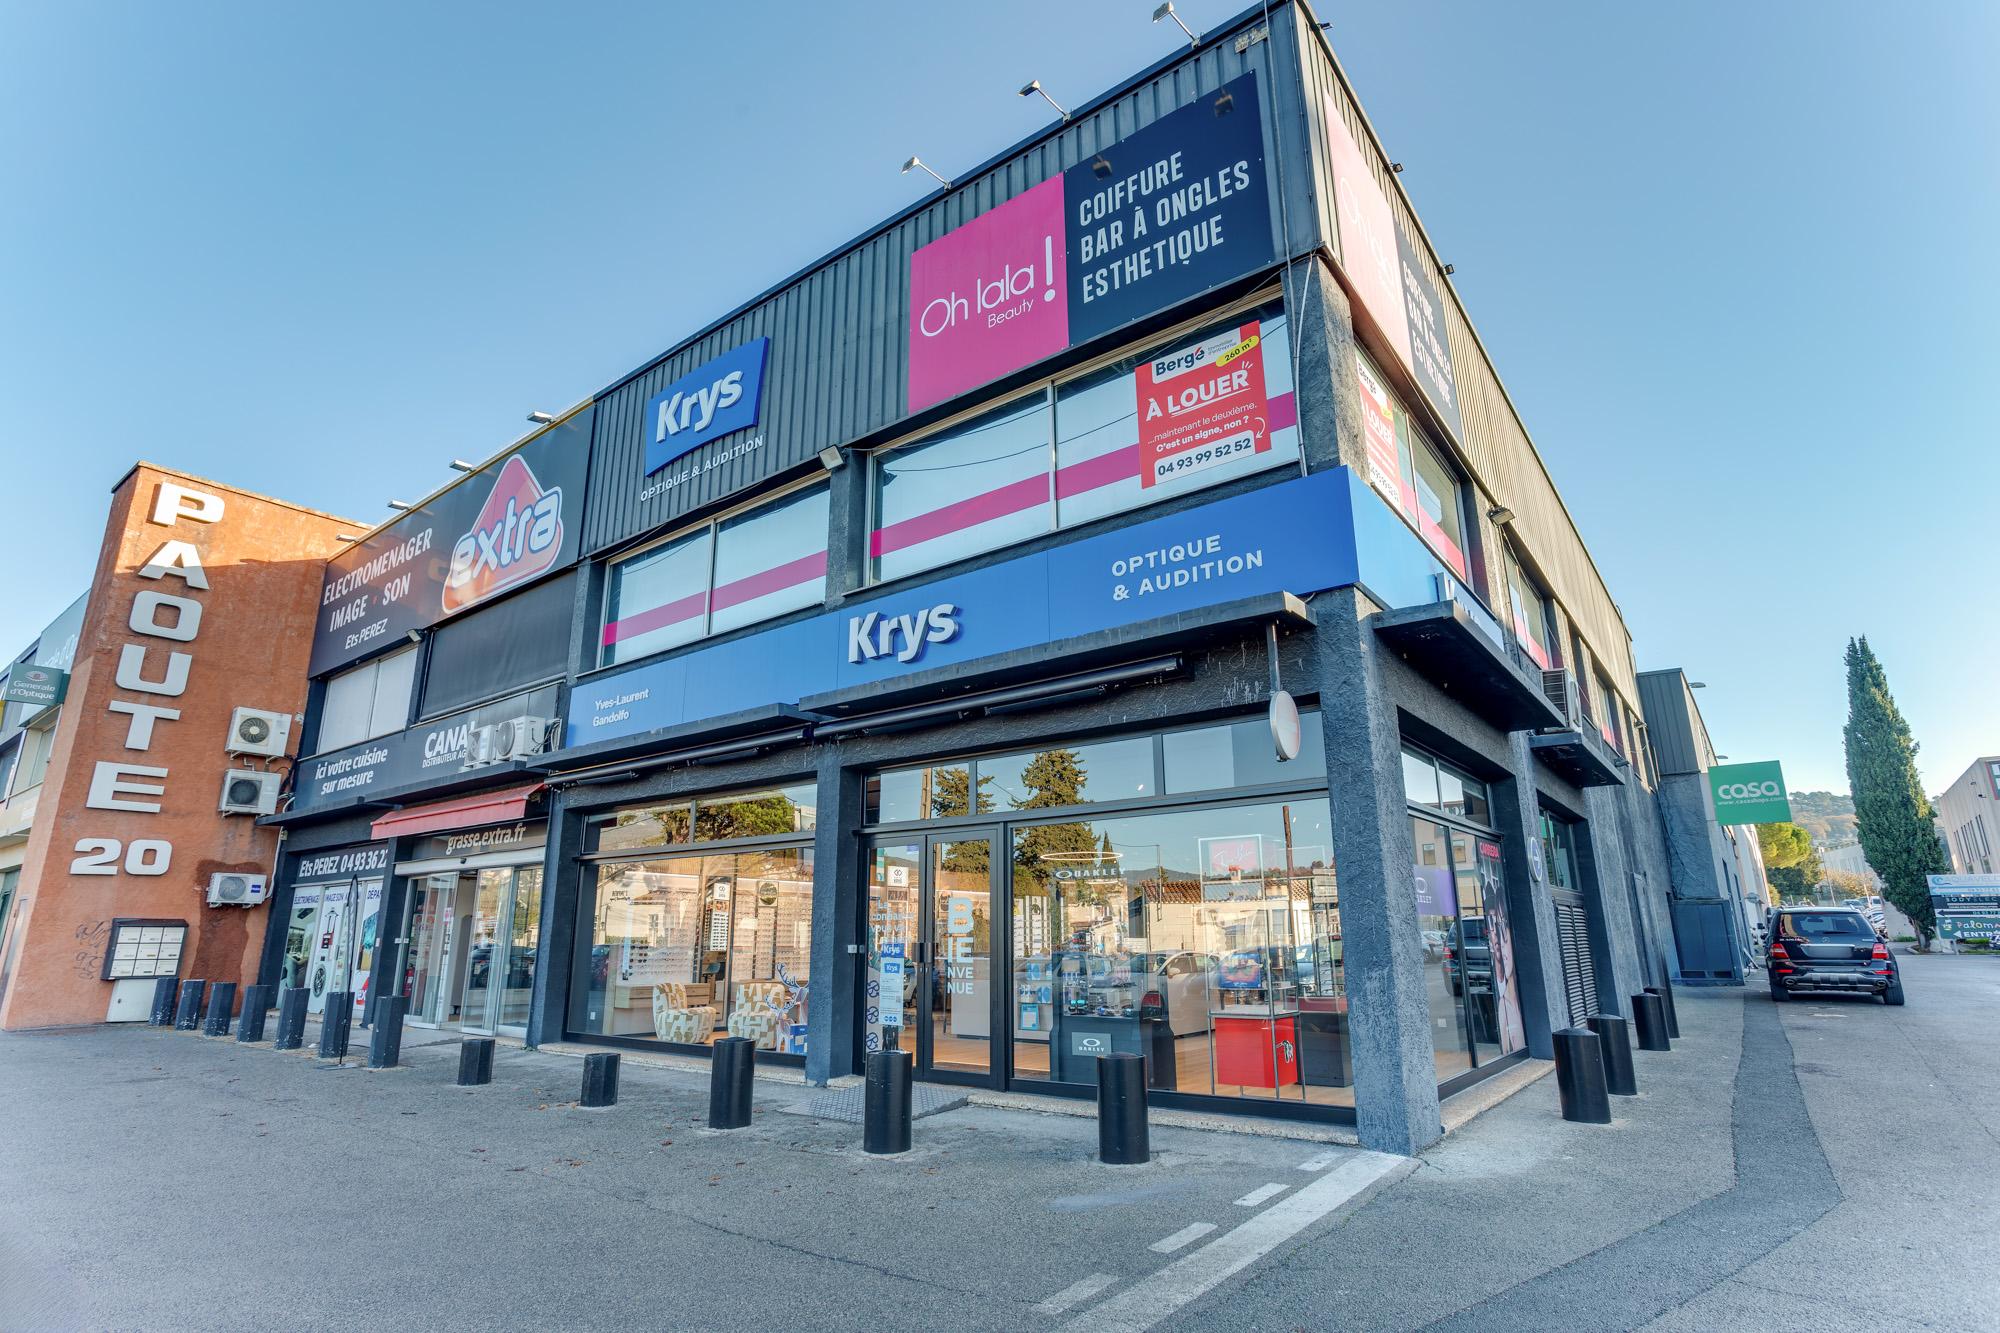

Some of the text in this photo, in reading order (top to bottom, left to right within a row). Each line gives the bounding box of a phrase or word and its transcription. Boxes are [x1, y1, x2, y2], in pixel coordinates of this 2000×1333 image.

[1079, 151, 1183, 226] COIFFURE
[1081, 160, 1250, 264] BAR À ONGLES
[1083, 214, 1224, 304] ESTHETIQUE
[920, 291, 968, 336] Oh
[977, 264, 1034, 314] lala
[988, 298, 1034, 328] Beauty
[1155, 346, 1205, 377] Bergé
[1224, 348, 1241, 361] 260
[656, 370, 744, 443] Krys
[1145, 369, 1249, 422] À LOUER
[1156, 438, 1181, 452] C'est
[1182, 435, 1194, 444] un
[1194, 425, 1223, 443] signe,
[1224, 419, 1242, 430] non
[1202, 415, 1210, 425] le
[640, 435, 764, 502] OPTIQUE & AUDITION
[1158, 438, 1251, 476] 04 93 99 52 52
[450, 492, 561, 588] extra
[1111, 534, 1221, 577] OPTIQUE
[322, 528, 433, 605] ELECTROMENAGER
[1112, 550, 1263, 601] & AUDITION
[329, 572, 411, 632] IMAGE SON
[86, 481, 226, 813] PAOUTE
[345, 618, 388, 650] Ets PEREZ
[848, 603, 958, 664] Krys
[594, 688, 649, 711] Yves-Laurent
[592, 709, 630, 727] Gandolfo
[315, 747, 388, 780] ici votre cuisine
[422, 752, 457, 769] DISTRIBUTEUR
[320, 770, 374, 795] sur mesure
[1718, 780, 1780, 800] casa
[446, 822, 527, 855] grasse.extra.fr
[70, 838, 173, 876] 20
[299, 860, 314, 877] Ets
[312, 856, 340, 876] PEREZ
[883, 944, 901, 956] Krys
[886, 964, 898, 973] Krys
